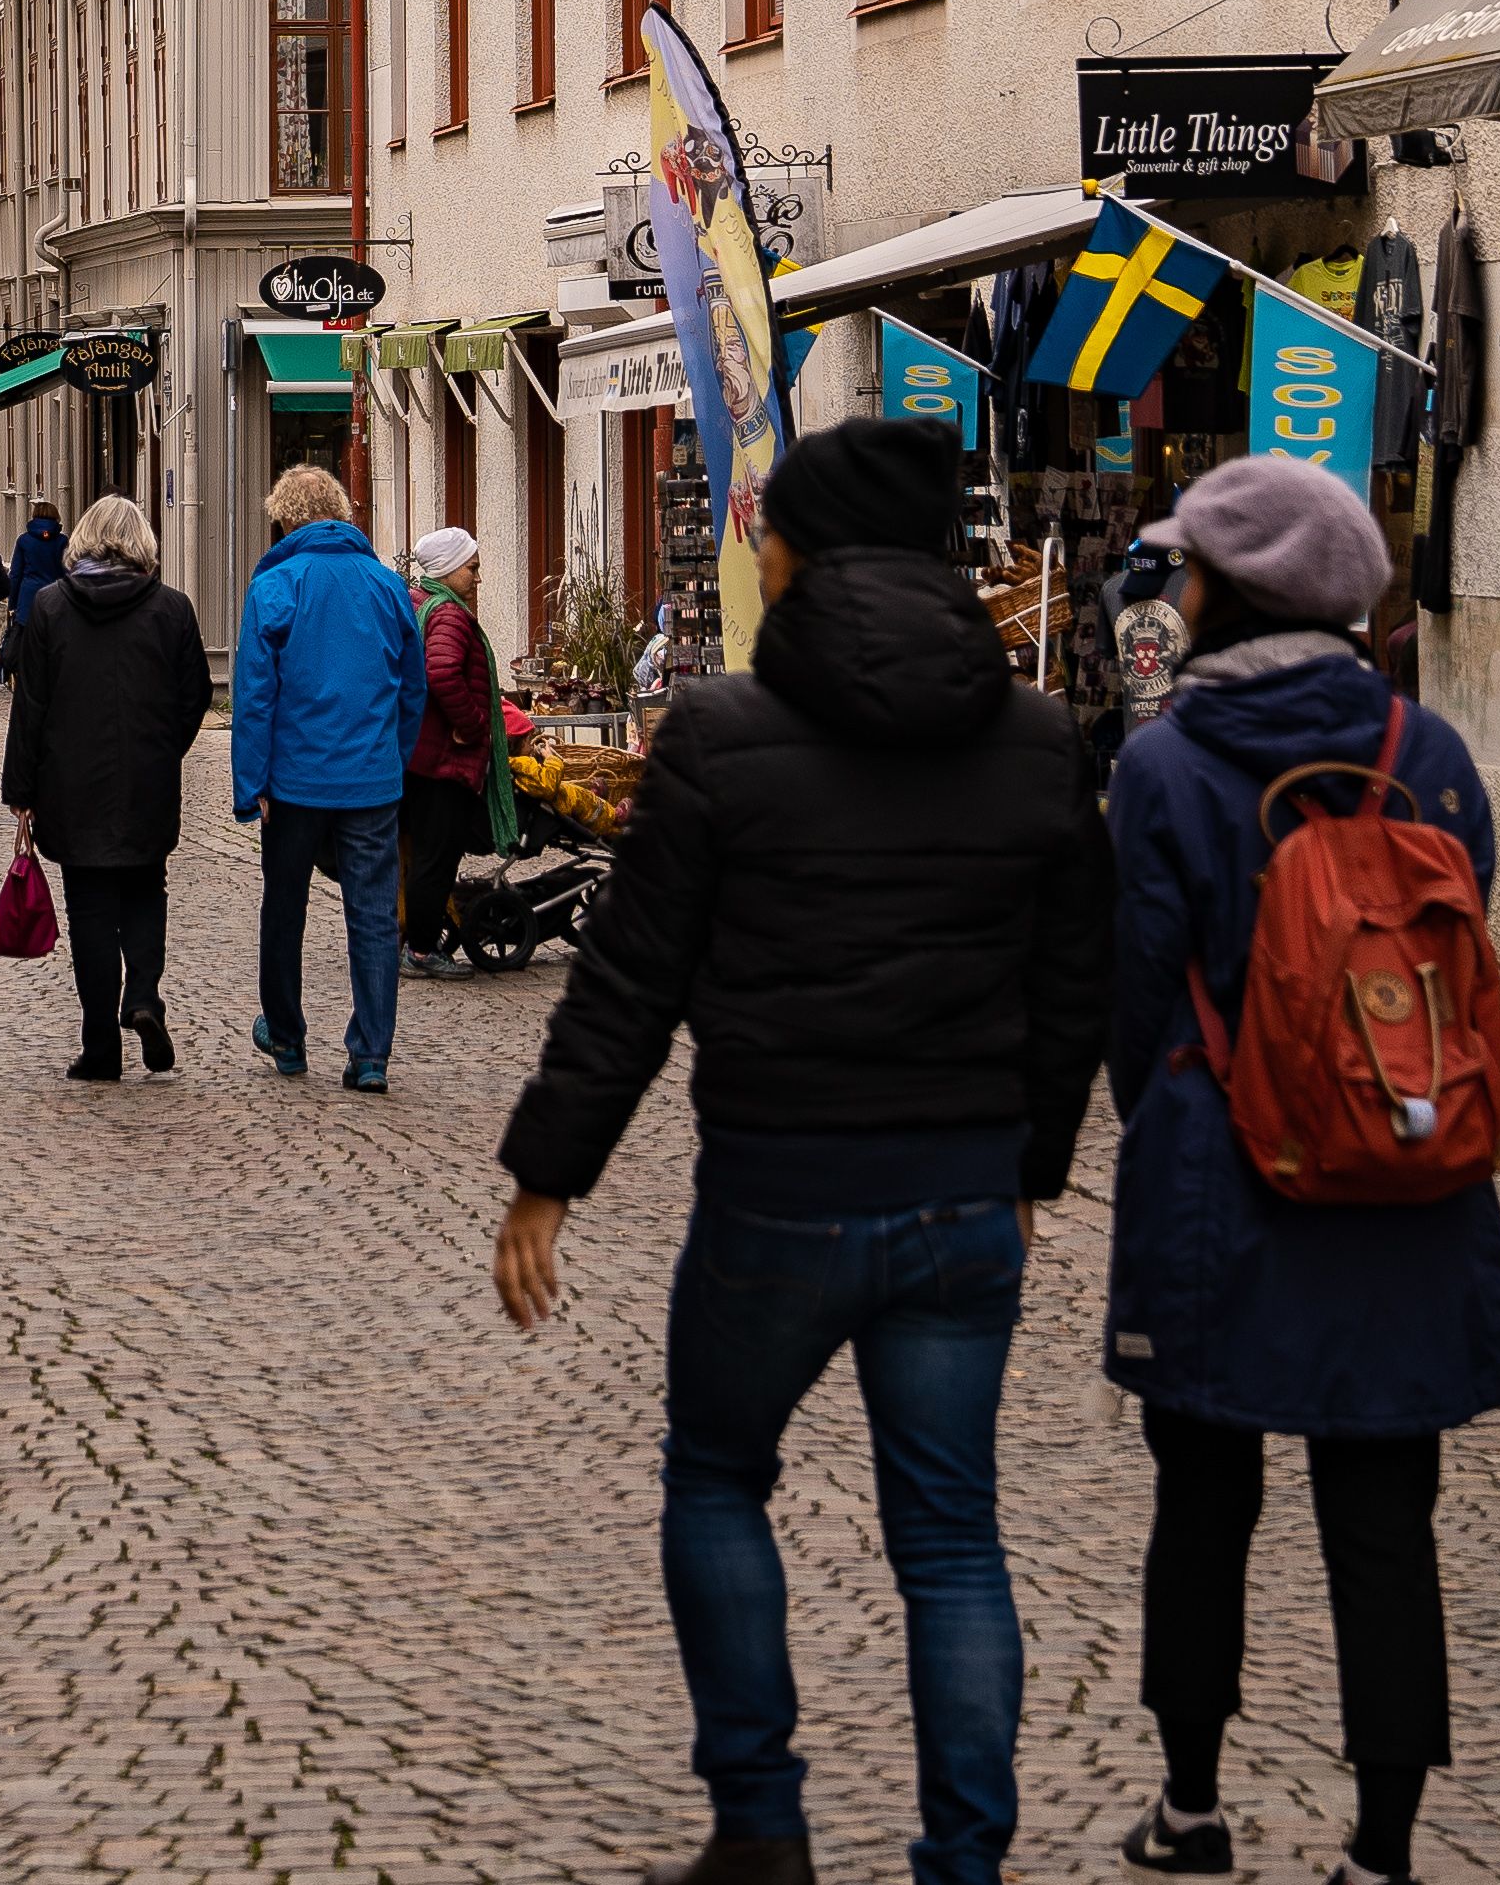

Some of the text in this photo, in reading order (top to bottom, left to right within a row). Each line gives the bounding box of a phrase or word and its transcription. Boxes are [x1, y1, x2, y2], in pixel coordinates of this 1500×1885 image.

[1093, 111, 1292, 163] Little Things
[1125, 157, 1251, 177] Souvenir & gift shop
[356, 287, 375, 301] etc
[84, 362, 133, 380] Antik
[619, 356, 653, 398] Little
